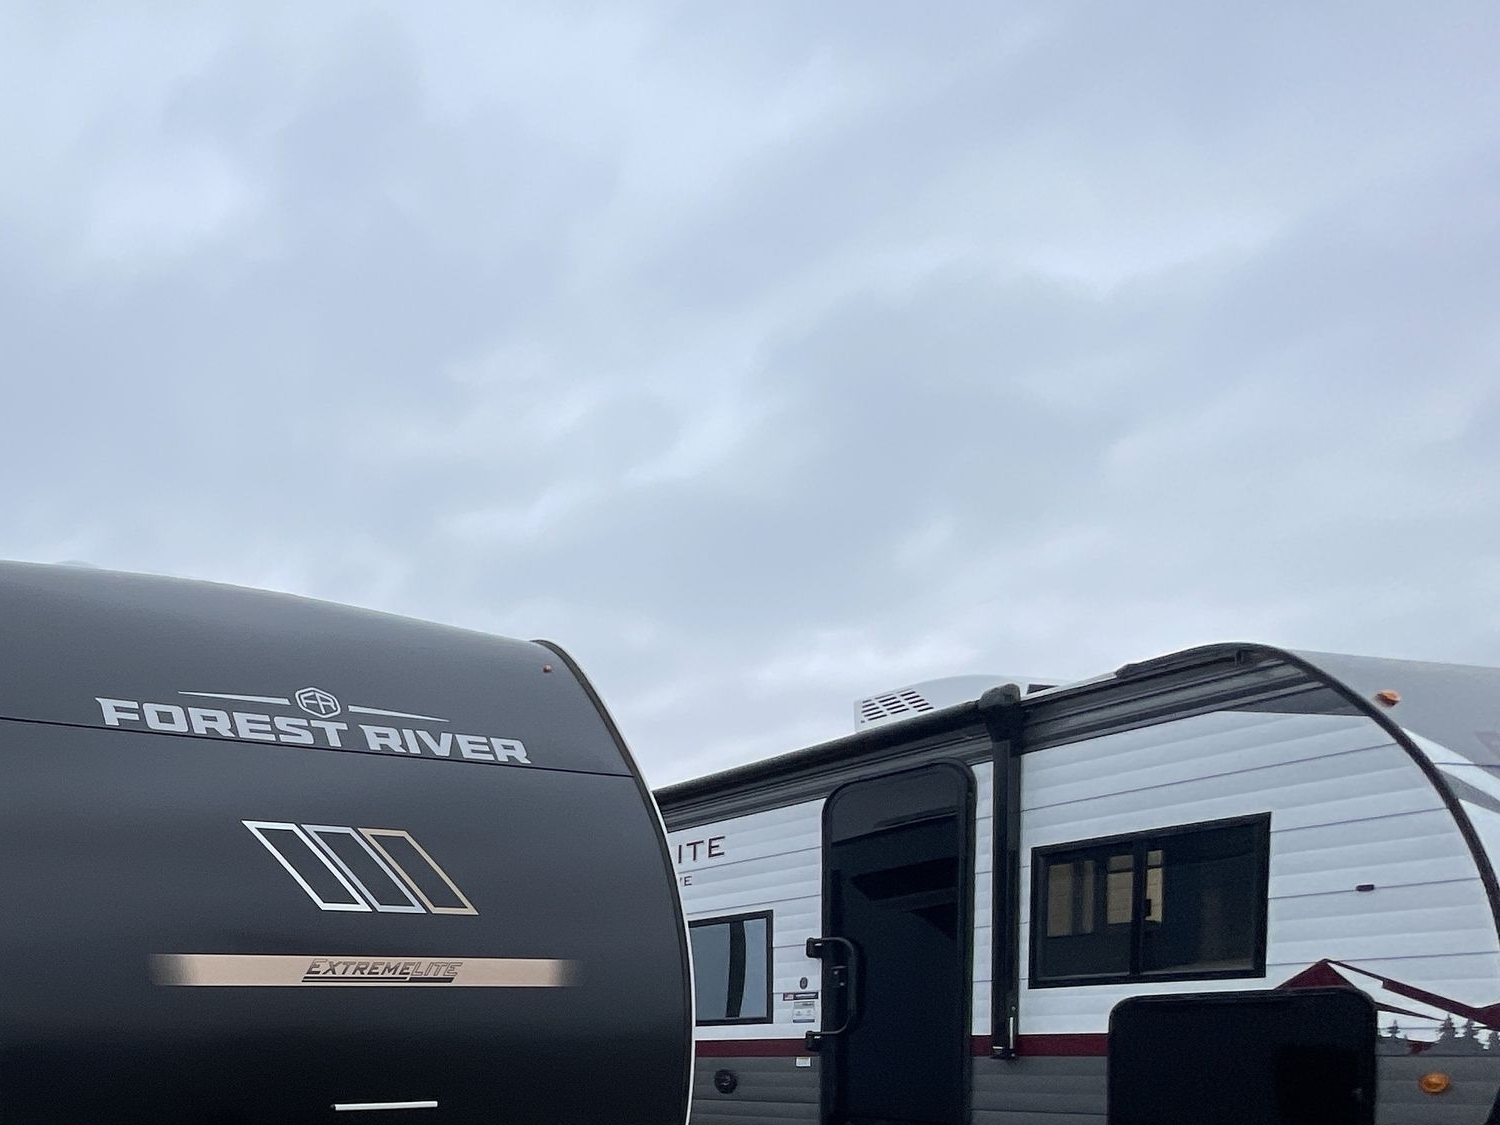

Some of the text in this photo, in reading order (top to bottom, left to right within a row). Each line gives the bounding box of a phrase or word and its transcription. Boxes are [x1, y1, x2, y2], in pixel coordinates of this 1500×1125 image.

[95, 697, 531, 764] FOREST RIVER
[305, 958, 463, 977] EXTREMELITE
